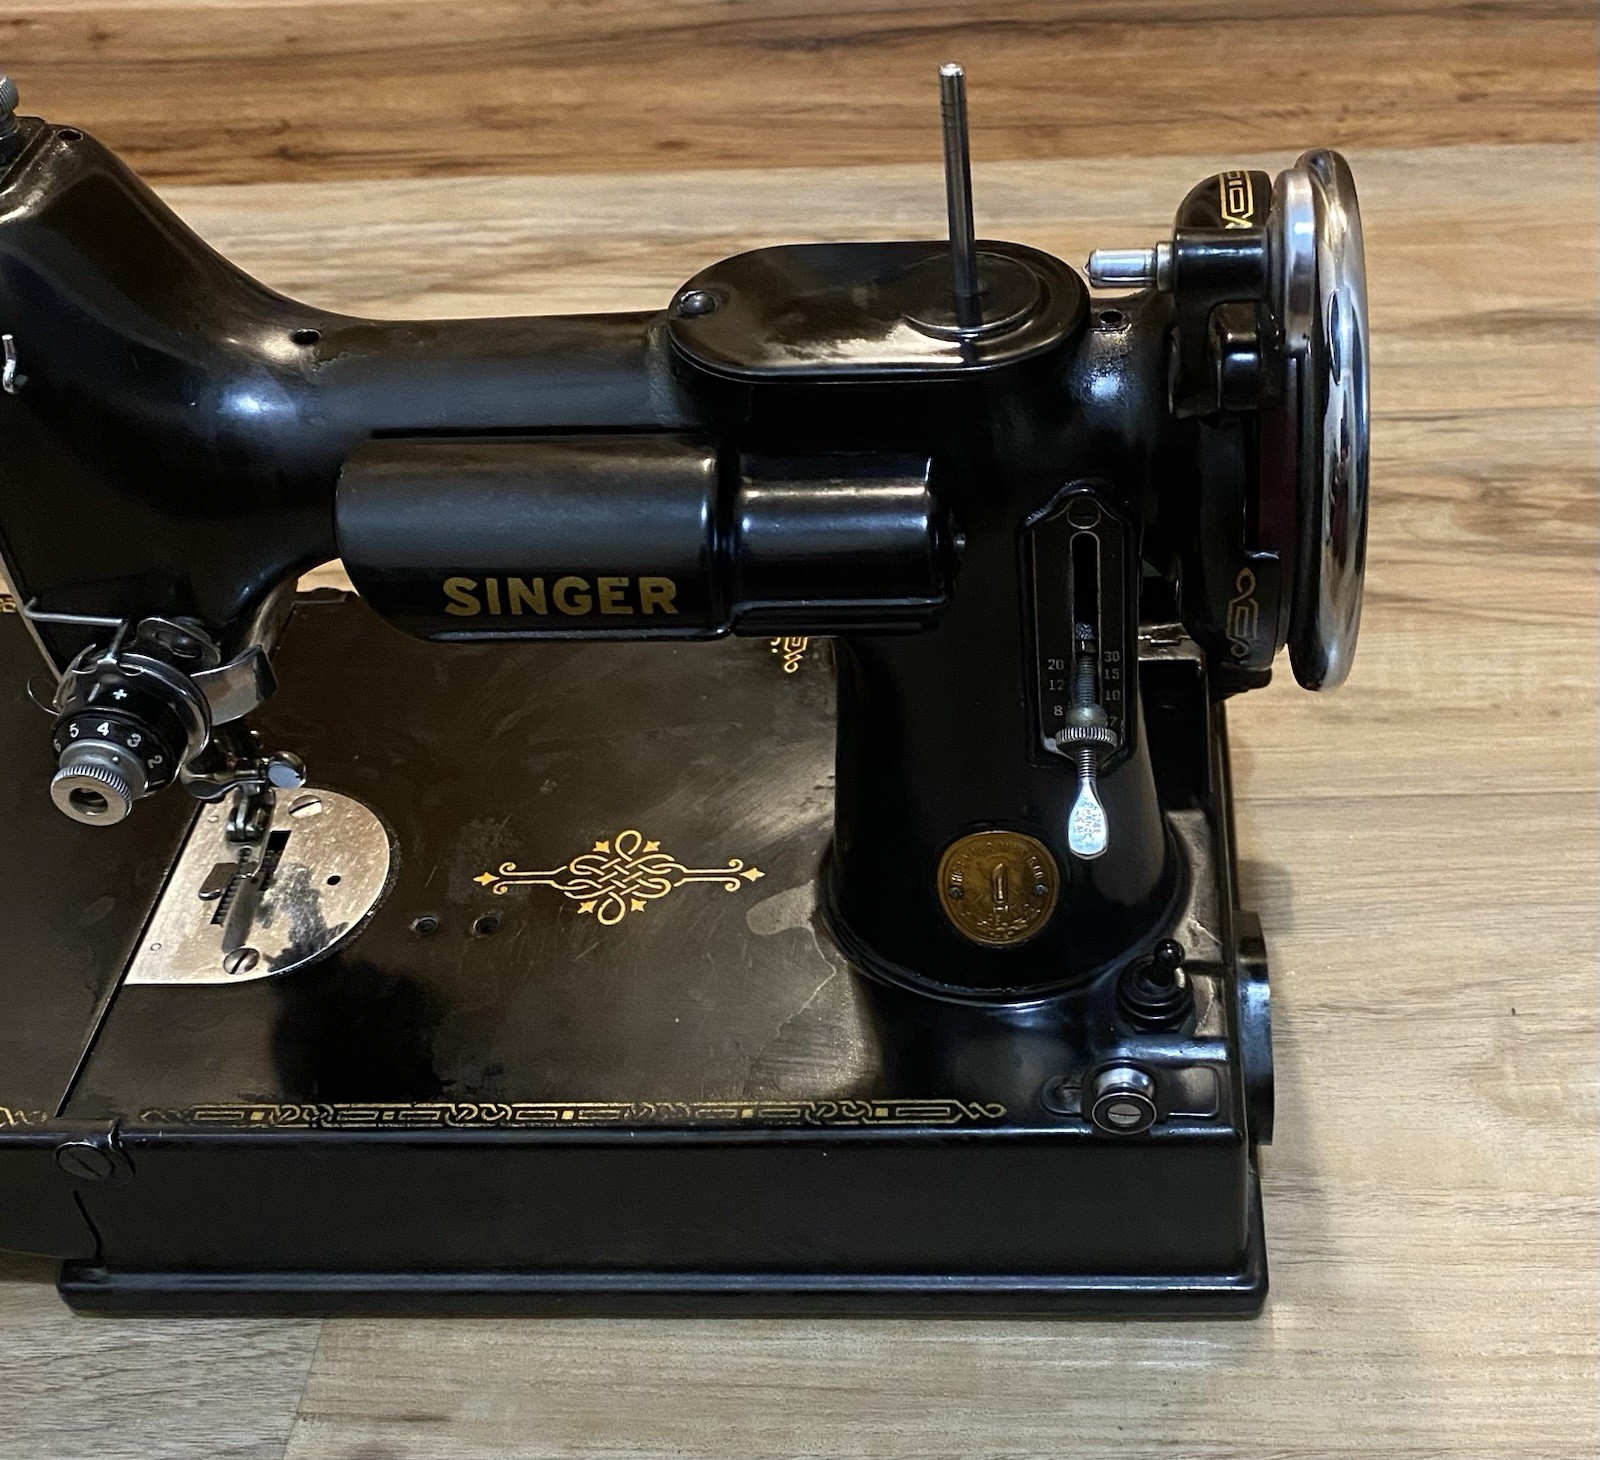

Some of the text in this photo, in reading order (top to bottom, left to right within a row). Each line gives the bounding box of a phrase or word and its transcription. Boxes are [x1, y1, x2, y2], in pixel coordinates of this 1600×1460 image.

[443, 576, 679, 616] SINGER
[1103, 651, 1120, 662] 30
[1047, 658, 1064, 671] 20
[1103, 668, 1120, 680] 15
[1105, 689, 1120, 701] 10
[1053, 705, 1063, 716] 8
[69, 723, 79, 738] 5
[97, 722, 109, 736] 4
[127, 733, 141, 748] 3
[147, 755, 162, 769] 2
